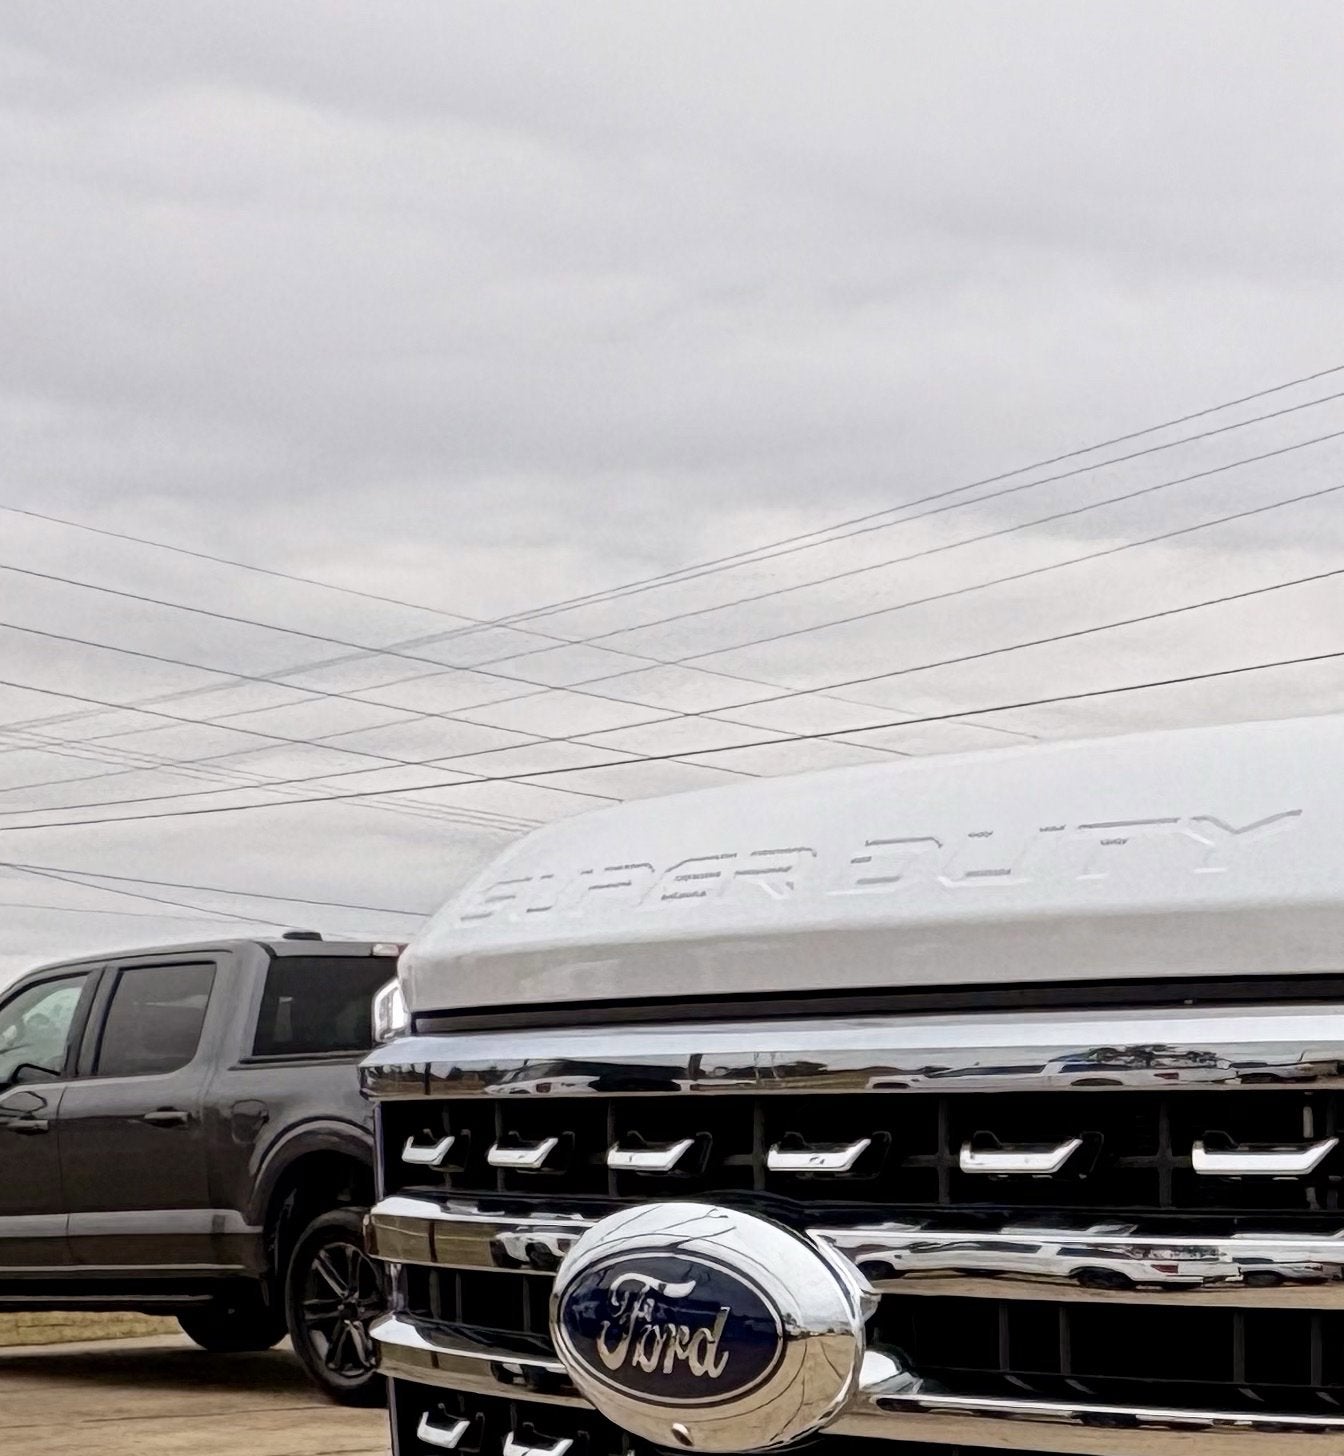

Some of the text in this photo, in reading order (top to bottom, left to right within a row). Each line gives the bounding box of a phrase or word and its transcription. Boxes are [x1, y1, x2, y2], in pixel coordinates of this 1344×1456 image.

[457, 808, 1304, 926] SUPER DUTY
[596, 1272, 731, 1379] Ford
